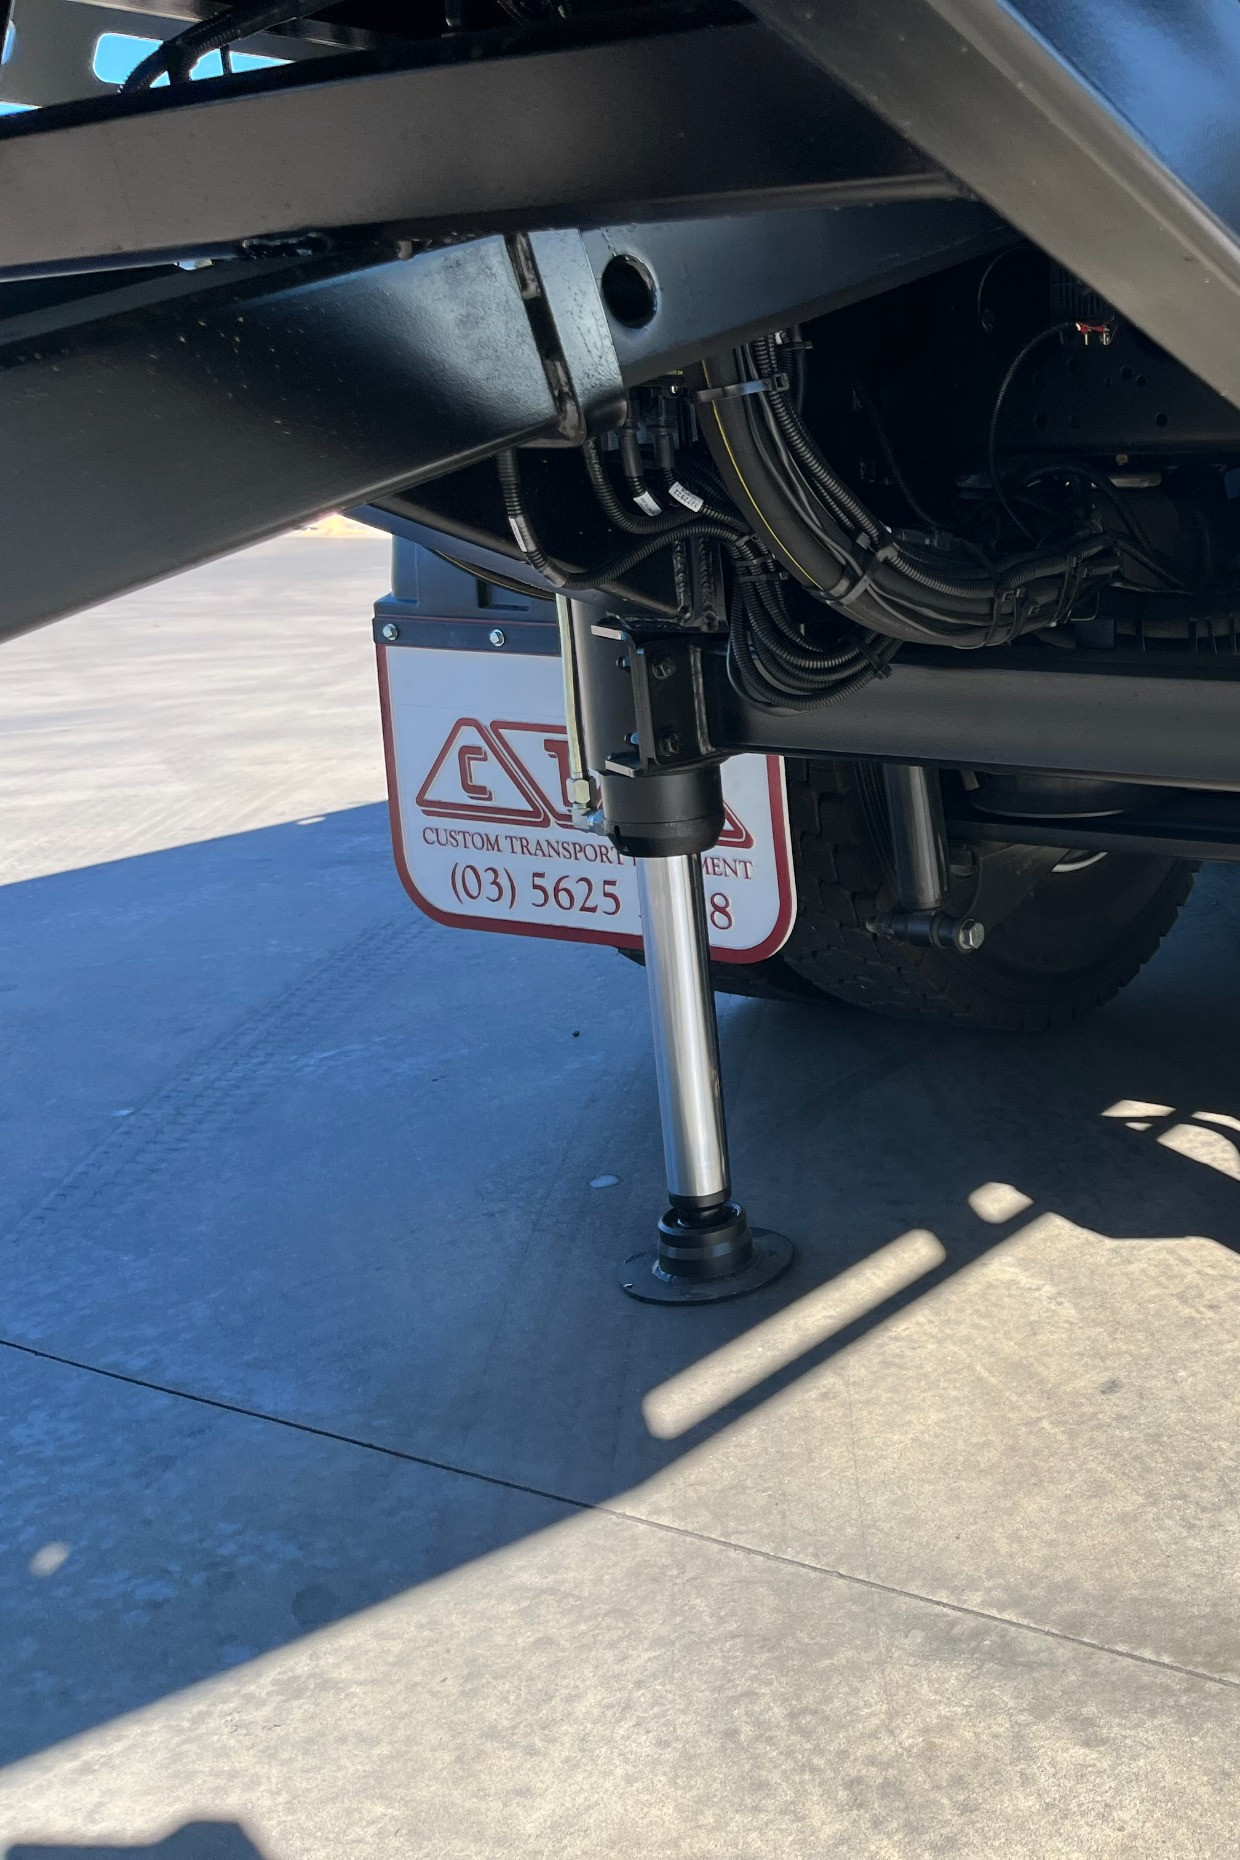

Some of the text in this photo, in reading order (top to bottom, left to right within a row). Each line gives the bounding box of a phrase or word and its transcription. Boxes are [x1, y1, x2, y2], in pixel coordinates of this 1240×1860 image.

[457, 745, 493, 802] C
[422, 826, 502, 854] CUSTOM
[449, 862, 622, 916] (03) 5625
